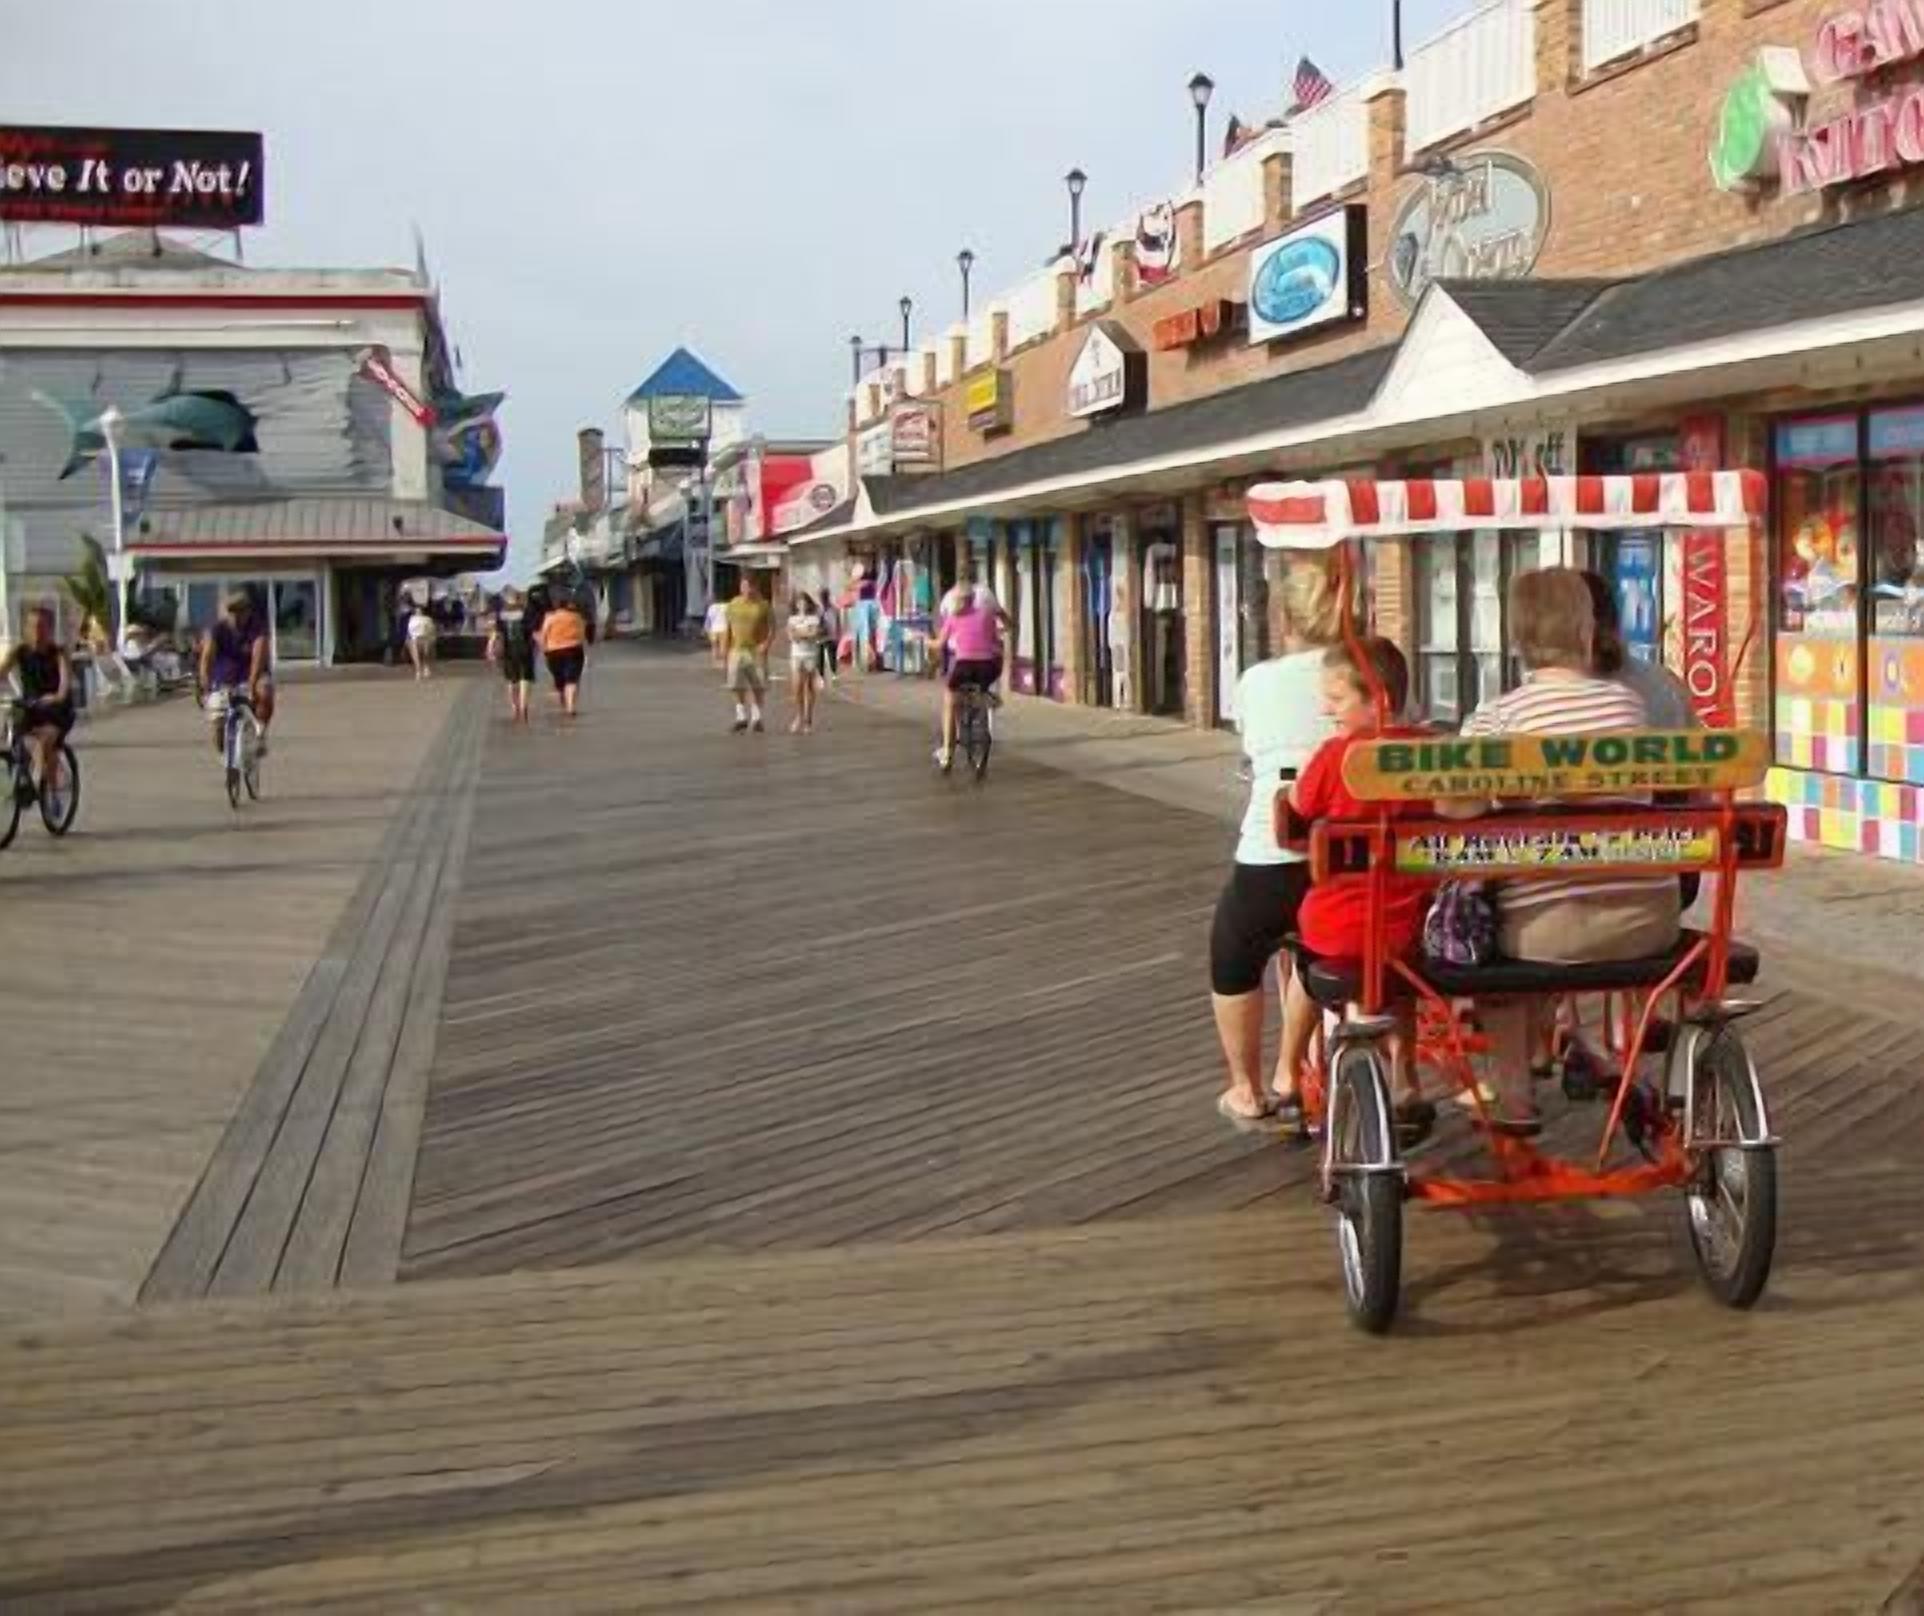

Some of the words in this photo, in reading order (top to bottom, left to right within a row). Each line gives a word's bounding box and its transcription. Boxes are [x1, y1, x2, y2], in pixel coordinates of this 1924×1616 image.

[77, 158, 110, 193] It
[123, 165, 163, 193] or
[170, 160, 250, 197] Not!
[1377, 740, 1513, 773] BIKE
[1541, 734, 1740, 770] WORLD
[1402, 773, 1571, 794] CAROLINE
[1585, 766, 1715, 791] STREET
